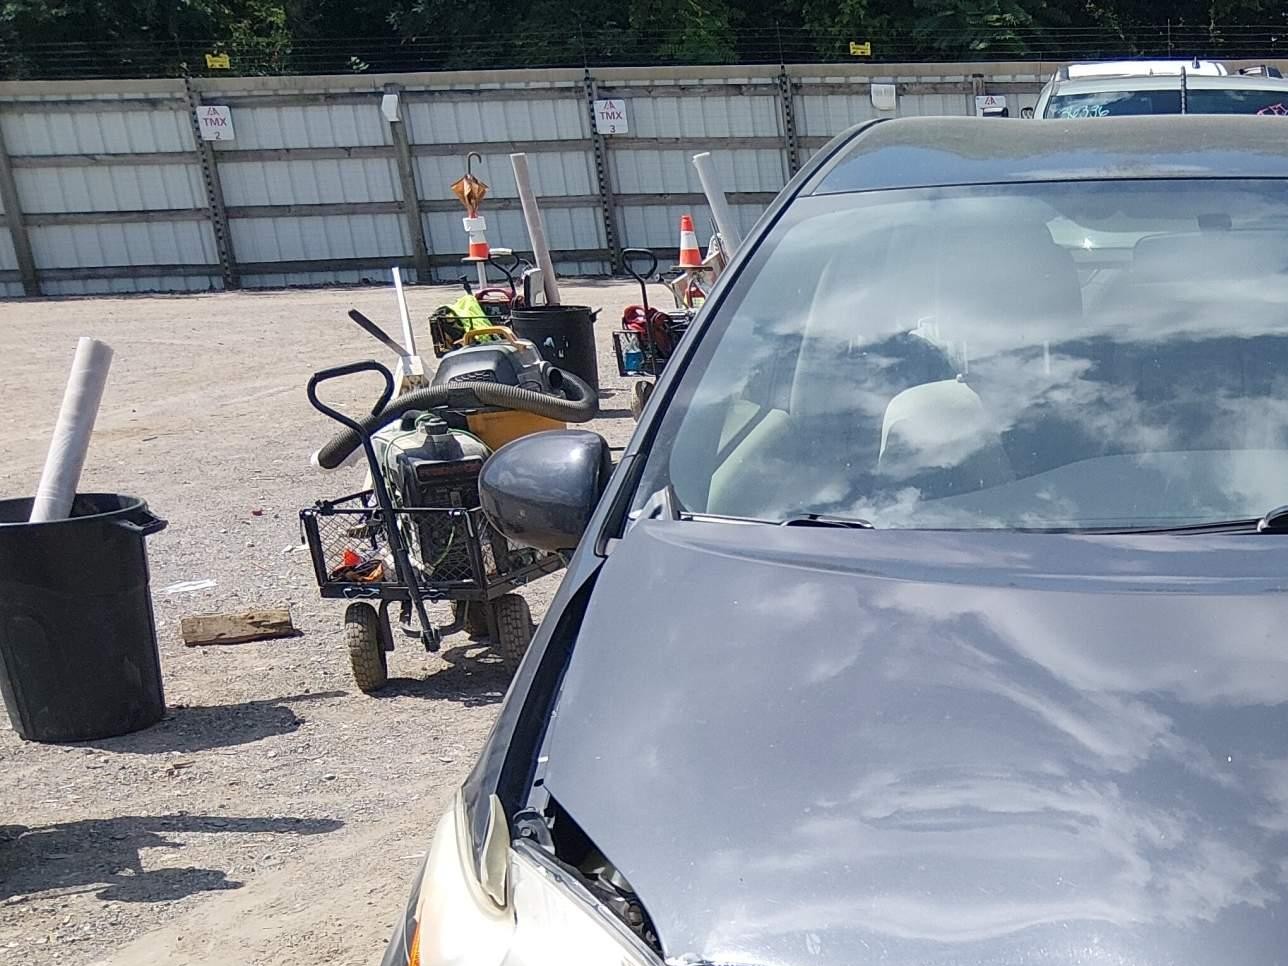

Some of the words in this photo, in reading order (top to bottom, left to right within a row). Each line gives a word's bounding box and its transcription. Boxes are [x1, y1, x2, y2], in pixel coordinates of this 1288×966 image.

[600, 111, 623, 120] TMX
[203, 117, 227, 127] TMX
[609, 124, 616, 133] 3
[214, 130, 222, 140] 2
